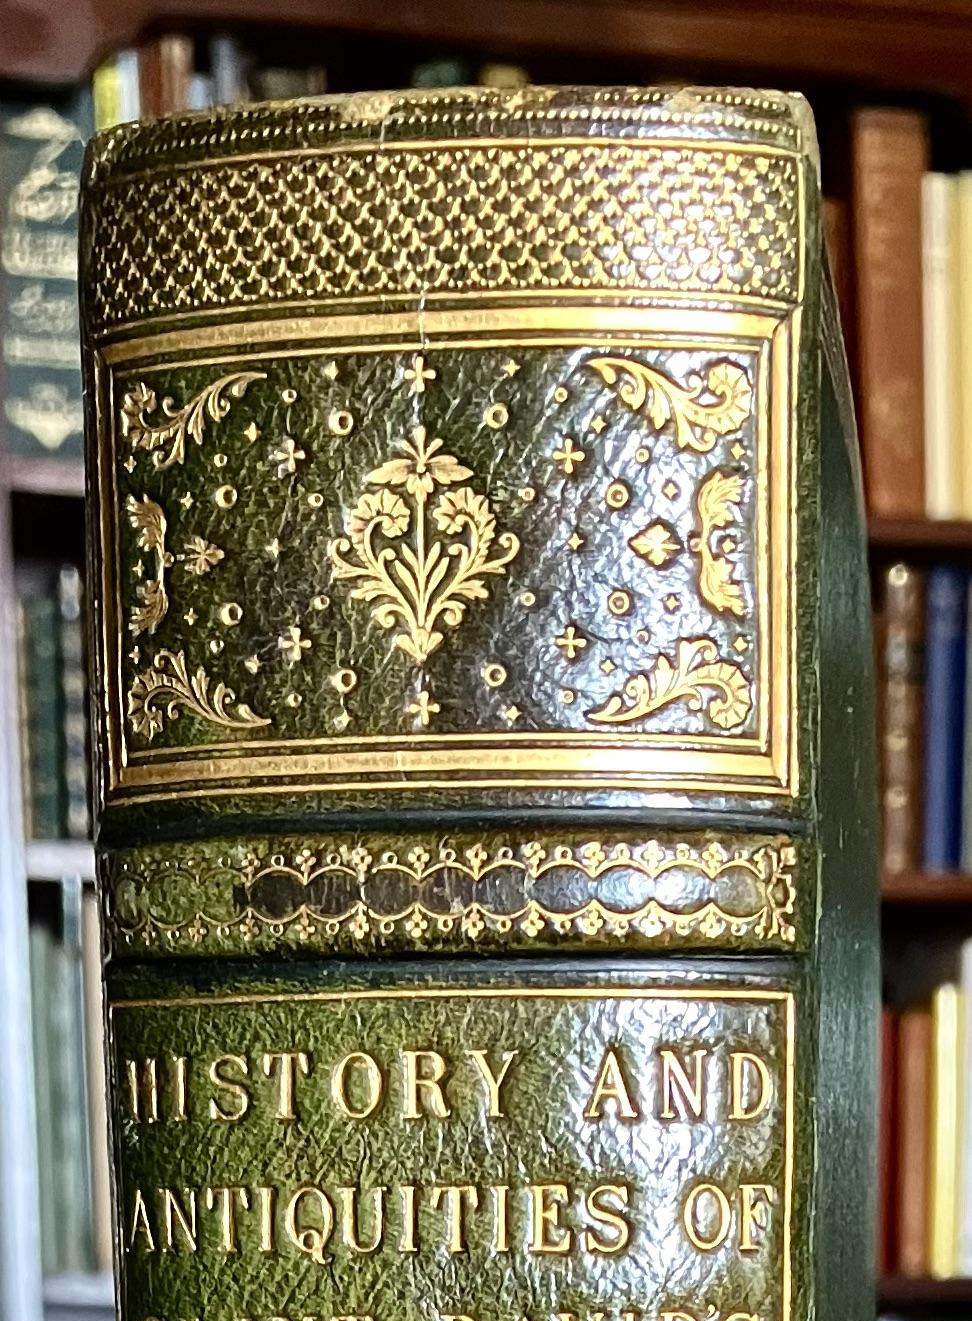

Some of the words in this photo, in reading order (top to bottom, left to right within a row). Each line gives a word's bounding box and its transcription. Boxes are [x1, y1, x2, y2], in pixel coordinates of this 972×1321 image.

[125, 1048, 518, 1124] HISTORY
[584, 1049, 773, 1121] AND
[123, 1184, 630, 1265] ANTIQUITIES
[683, 1183, 774, 1251] OF
